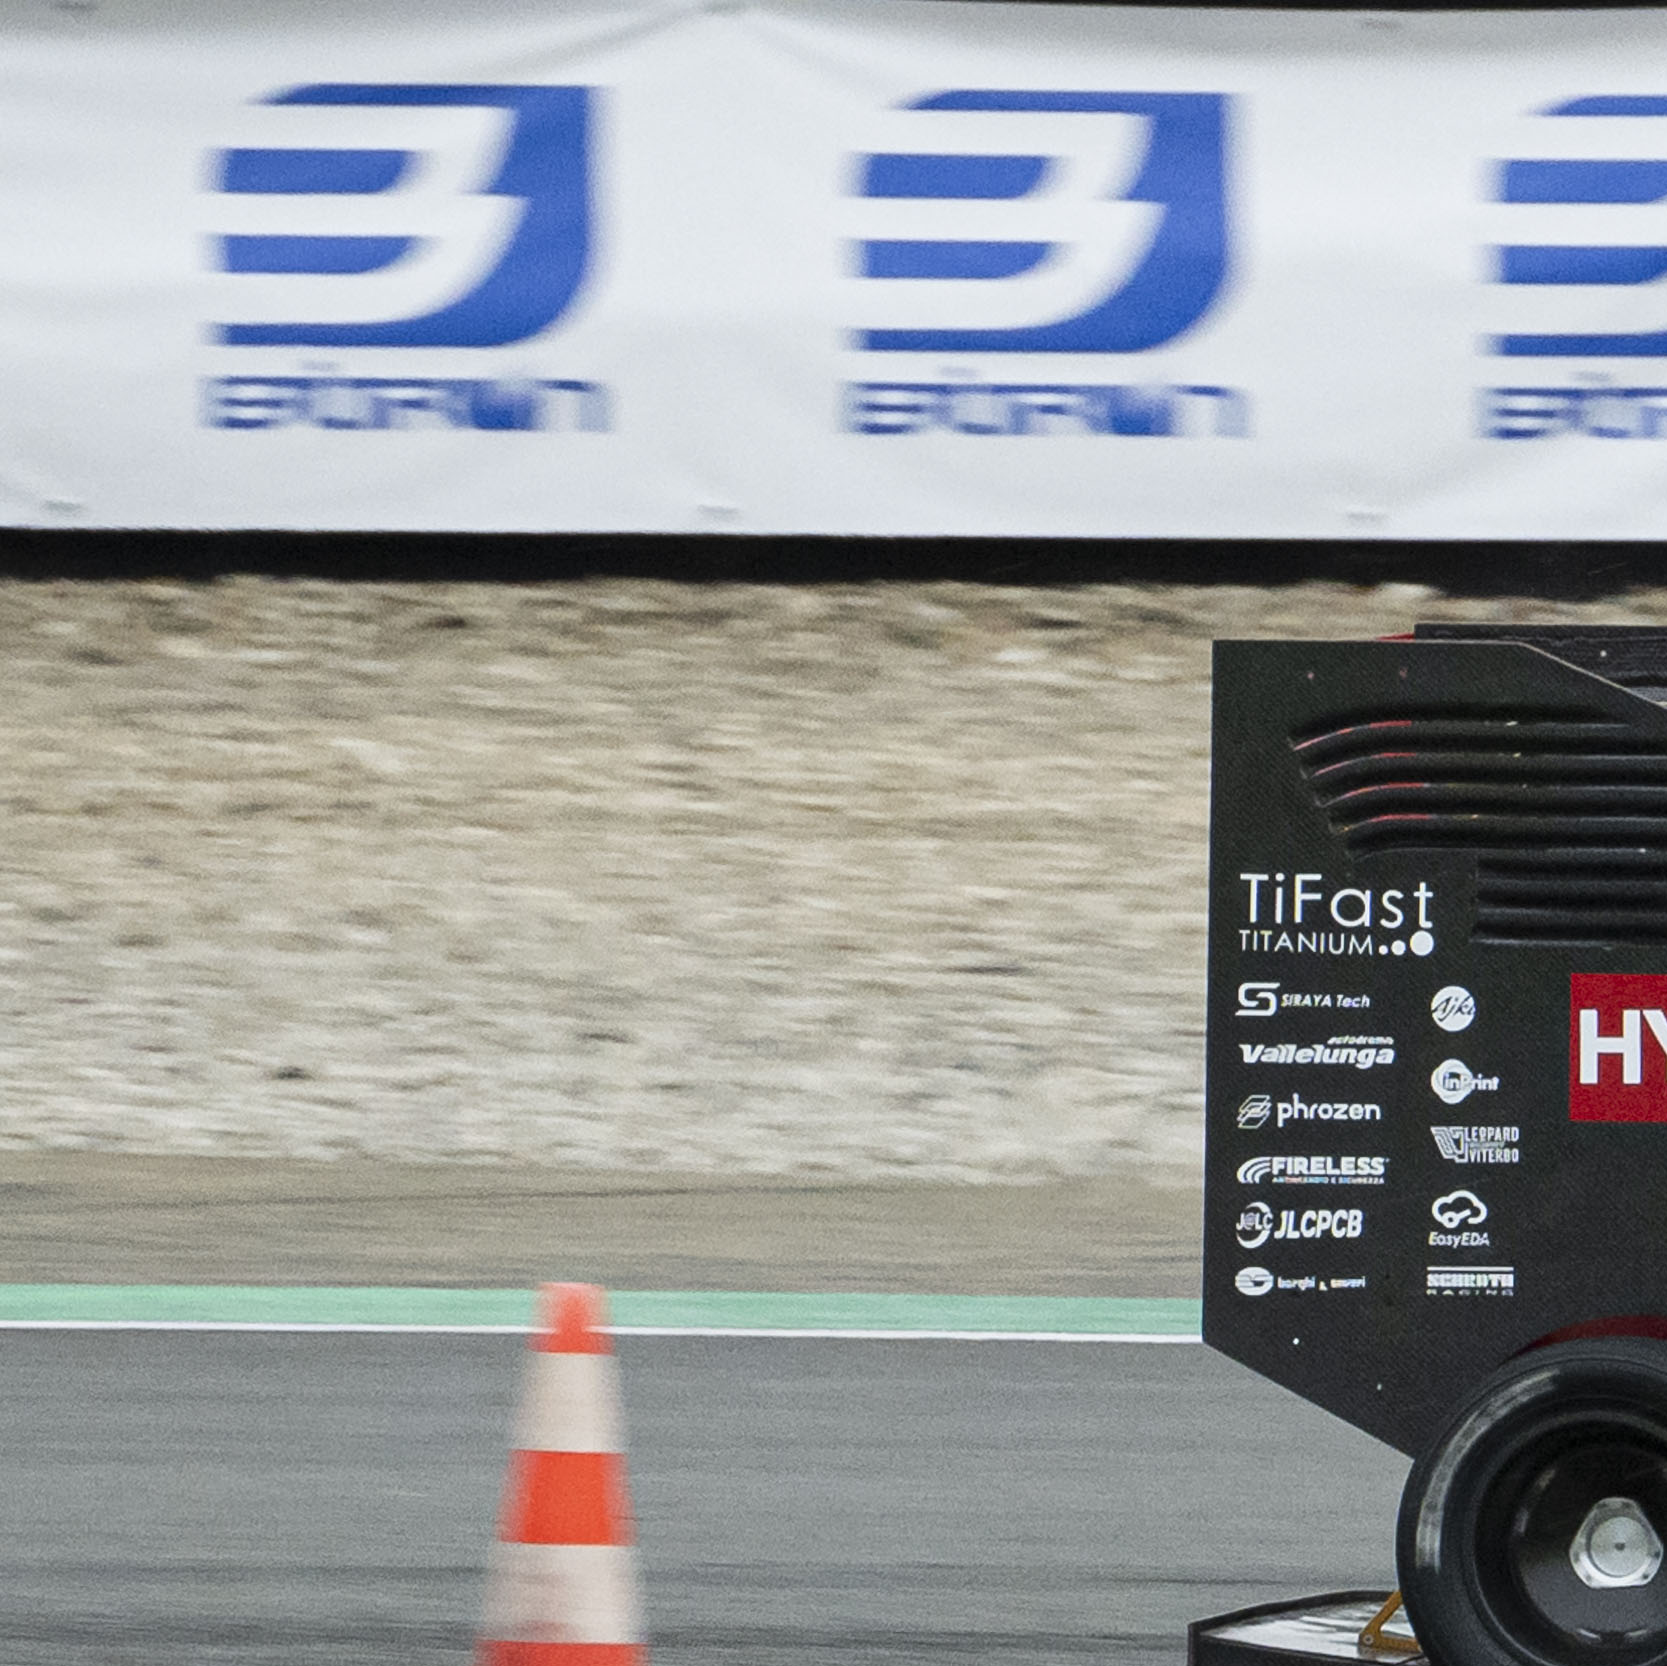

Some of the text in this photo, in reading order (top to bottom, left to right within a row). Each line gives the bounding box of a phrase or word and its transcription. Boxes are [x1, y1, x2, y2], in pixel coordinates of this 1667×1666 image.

[1239, 872, 1434, 930] TiFast
[1238, 929, 1374, 956] TITANIUM
[1280, 993, 1371, 1008] SIRAYA Tech
[1238, 1042, 1396, 1070] Vallelunga
[1276, 1092, 1382, 1128] phrozen
[1463, 1126, 1520, 1144] LEOPARD
[1271, 1208, 1364, 1240] JLCPCB
[1428, 1231, 1490, 1249] EasyEDA
